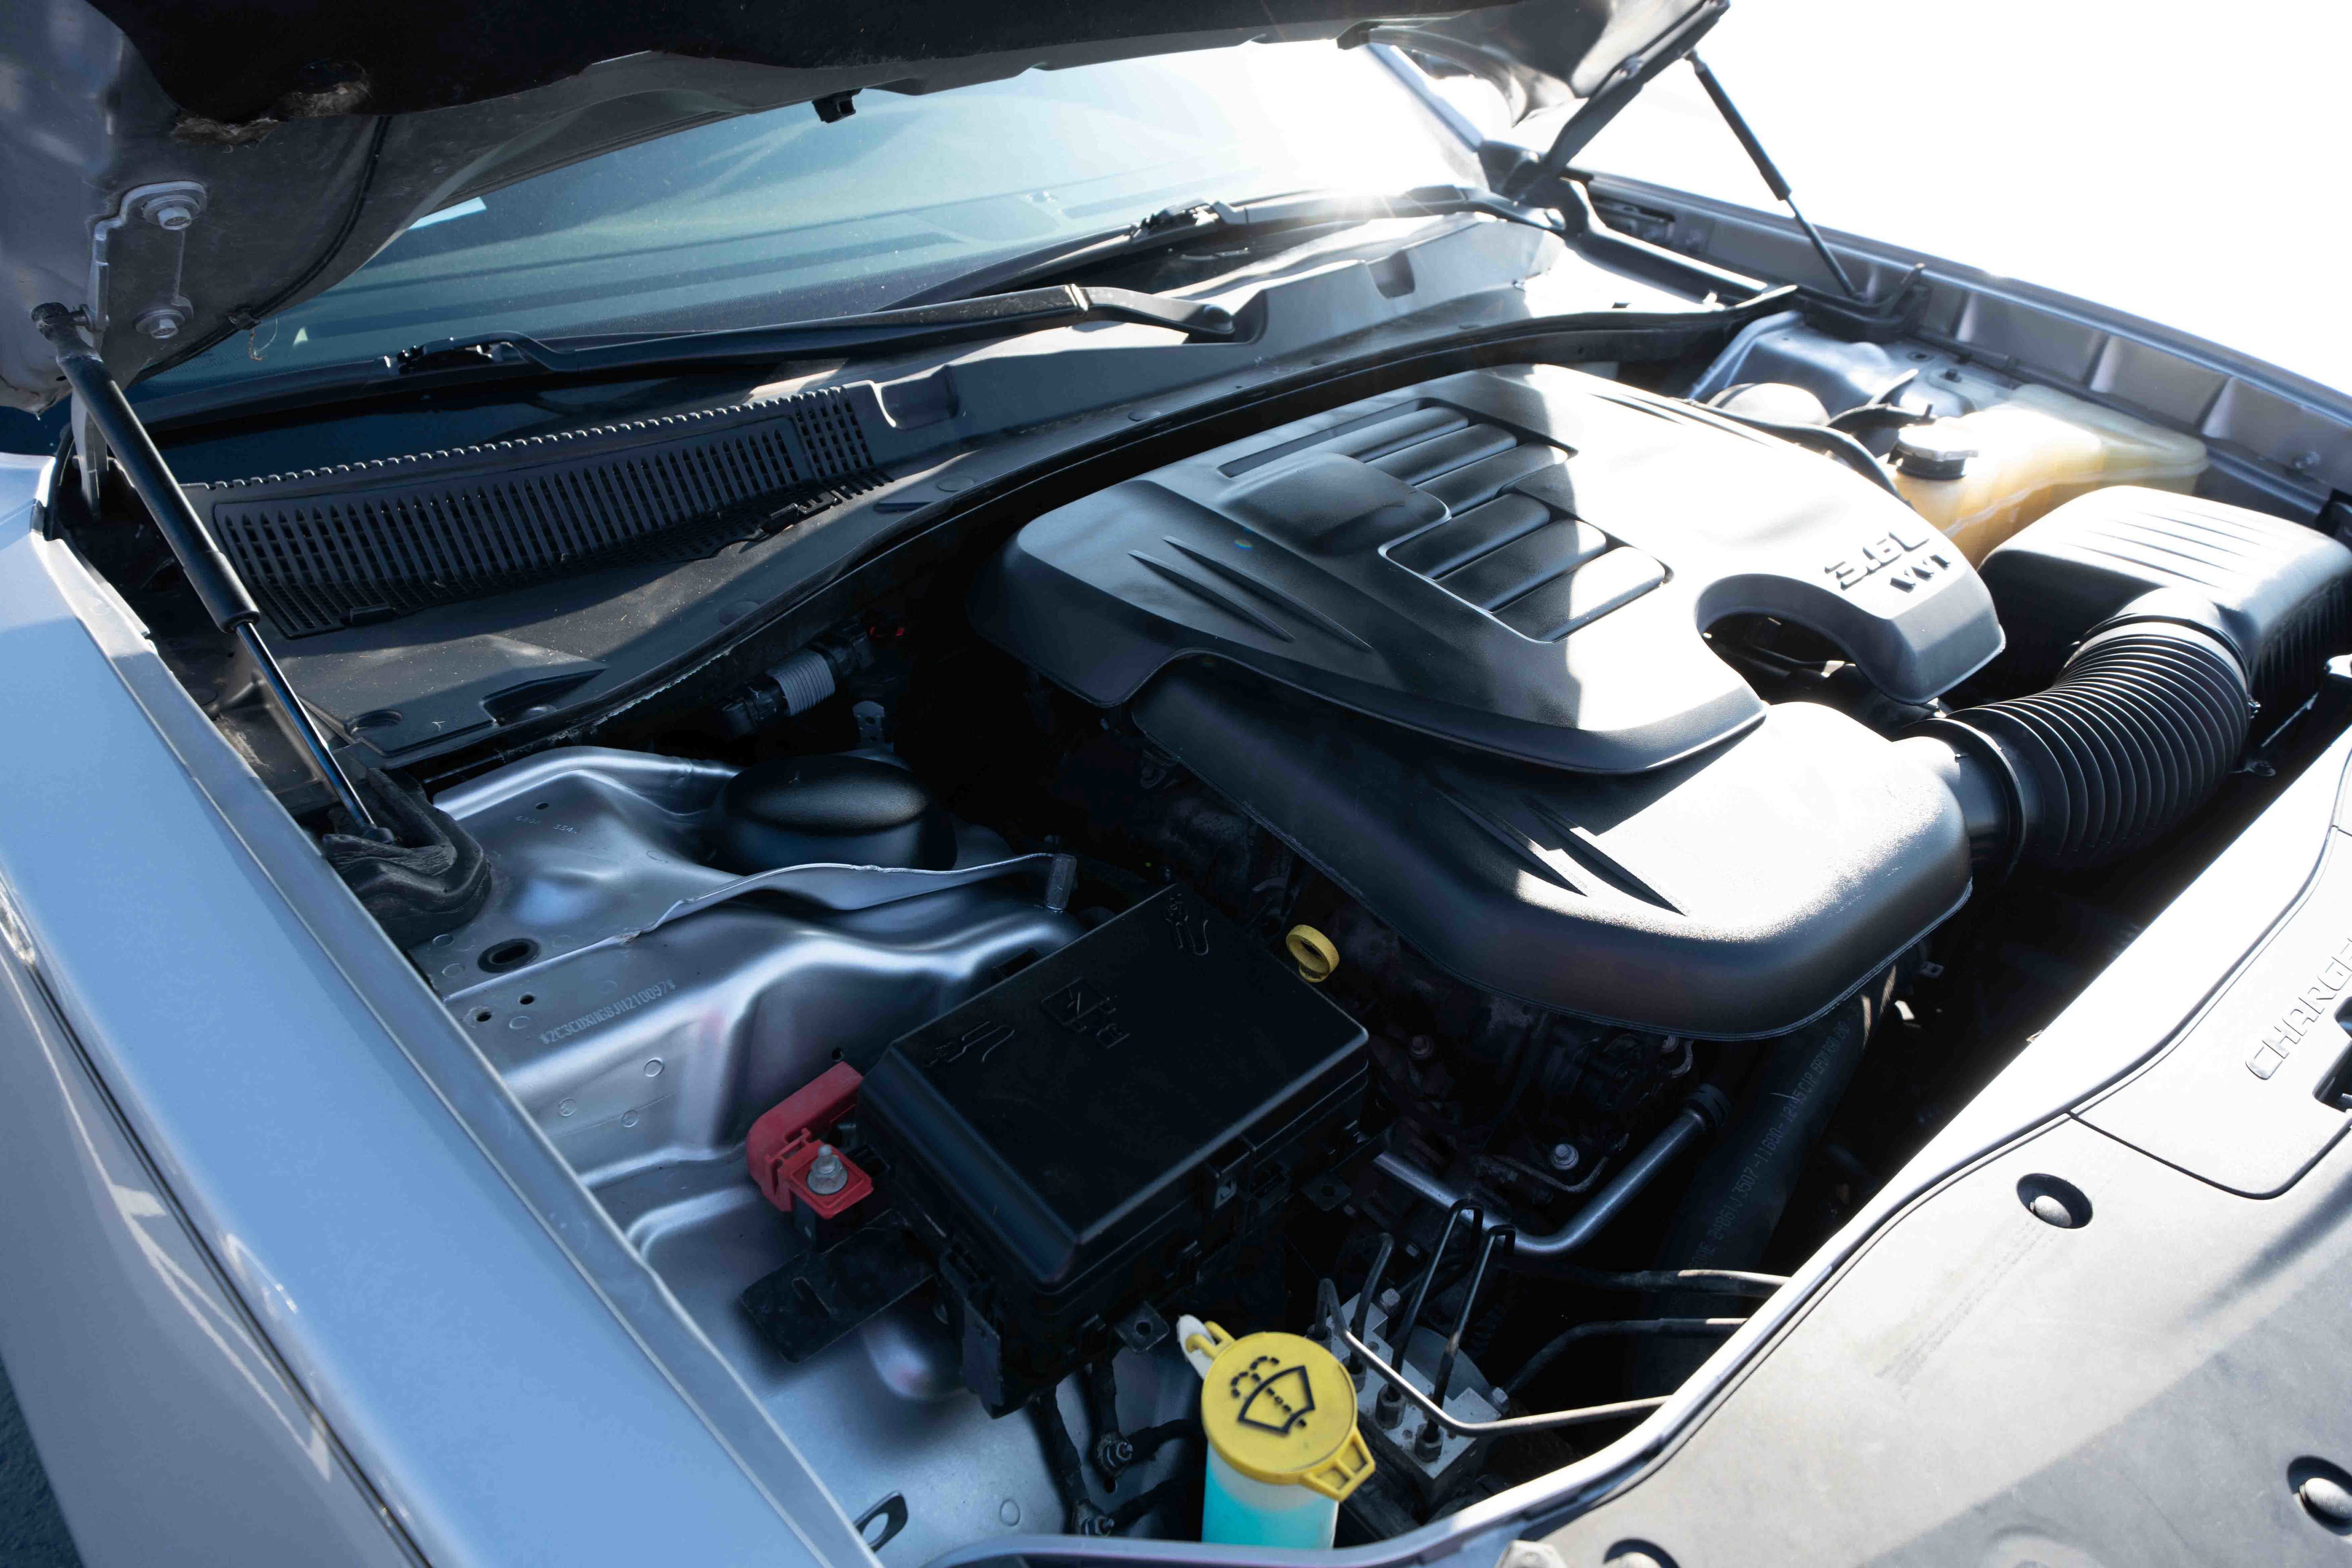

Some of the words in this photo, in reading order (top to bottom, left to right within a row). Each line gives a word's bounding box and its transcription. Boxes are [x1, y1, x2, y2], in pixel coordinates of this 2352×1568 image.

[1824, 531, 1931, 591] 3.6L
[1889, 548, 1952, 594] VVT
[2245, 937, 2352, 1081] CHARGE
